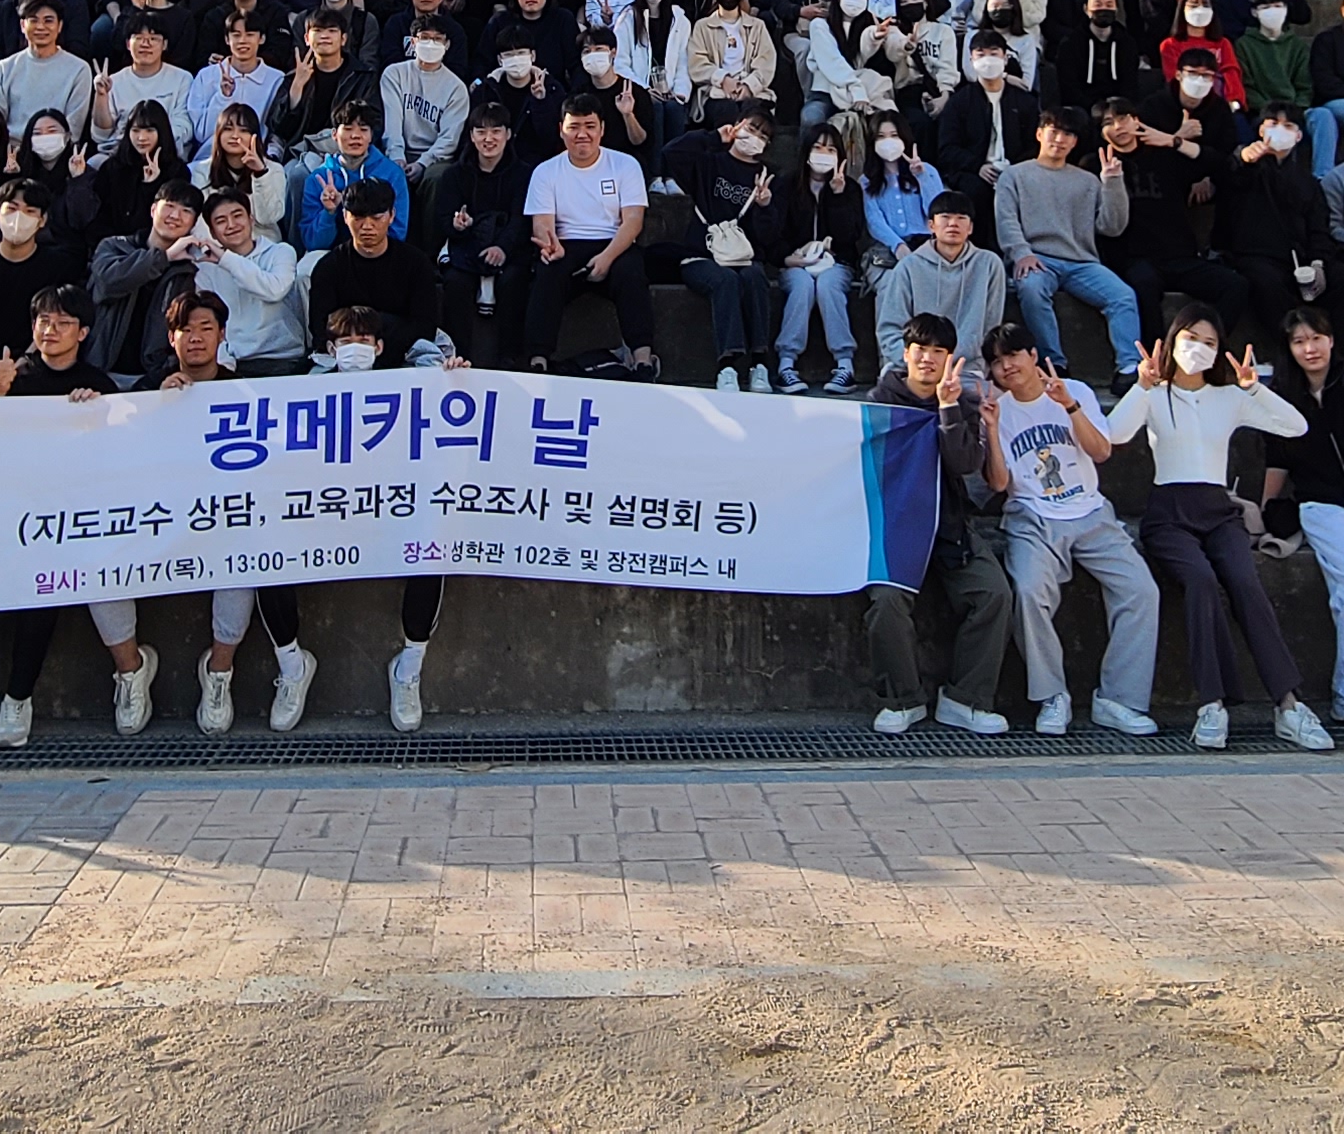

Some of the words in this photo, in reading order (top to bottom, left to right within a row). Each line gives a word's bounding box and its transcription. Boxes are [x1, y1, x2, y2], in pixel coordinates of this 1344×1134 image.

[203, 387, 498, 472] 광메카의
[530, 397, 600, 470] 날
[1009, 423, 1076, 462] STAYCATION
[17, 501, 174, 547] (지도교수
[186, 491, 267, 532] 상담,
[281, 482, 417, 521] 교육과정
[429, 481, 551, 522] 수요조사
[564, 491, 594, 525] 및
[606, 494, 703, 533] 설명회
[713, 501, 758, 535] 등)
[34, 568, 87, 595] 일시:
[97, 554, 214, 587] 11/17(목),
[224, 545, 361, 575] 13:00-18:00
[513, 545, 572, 568] 102호
[580, 549, 599, 572] 및
[606, 550, 710, 578] 장전캠퍼스
[717, 558, 738, 581] 내
